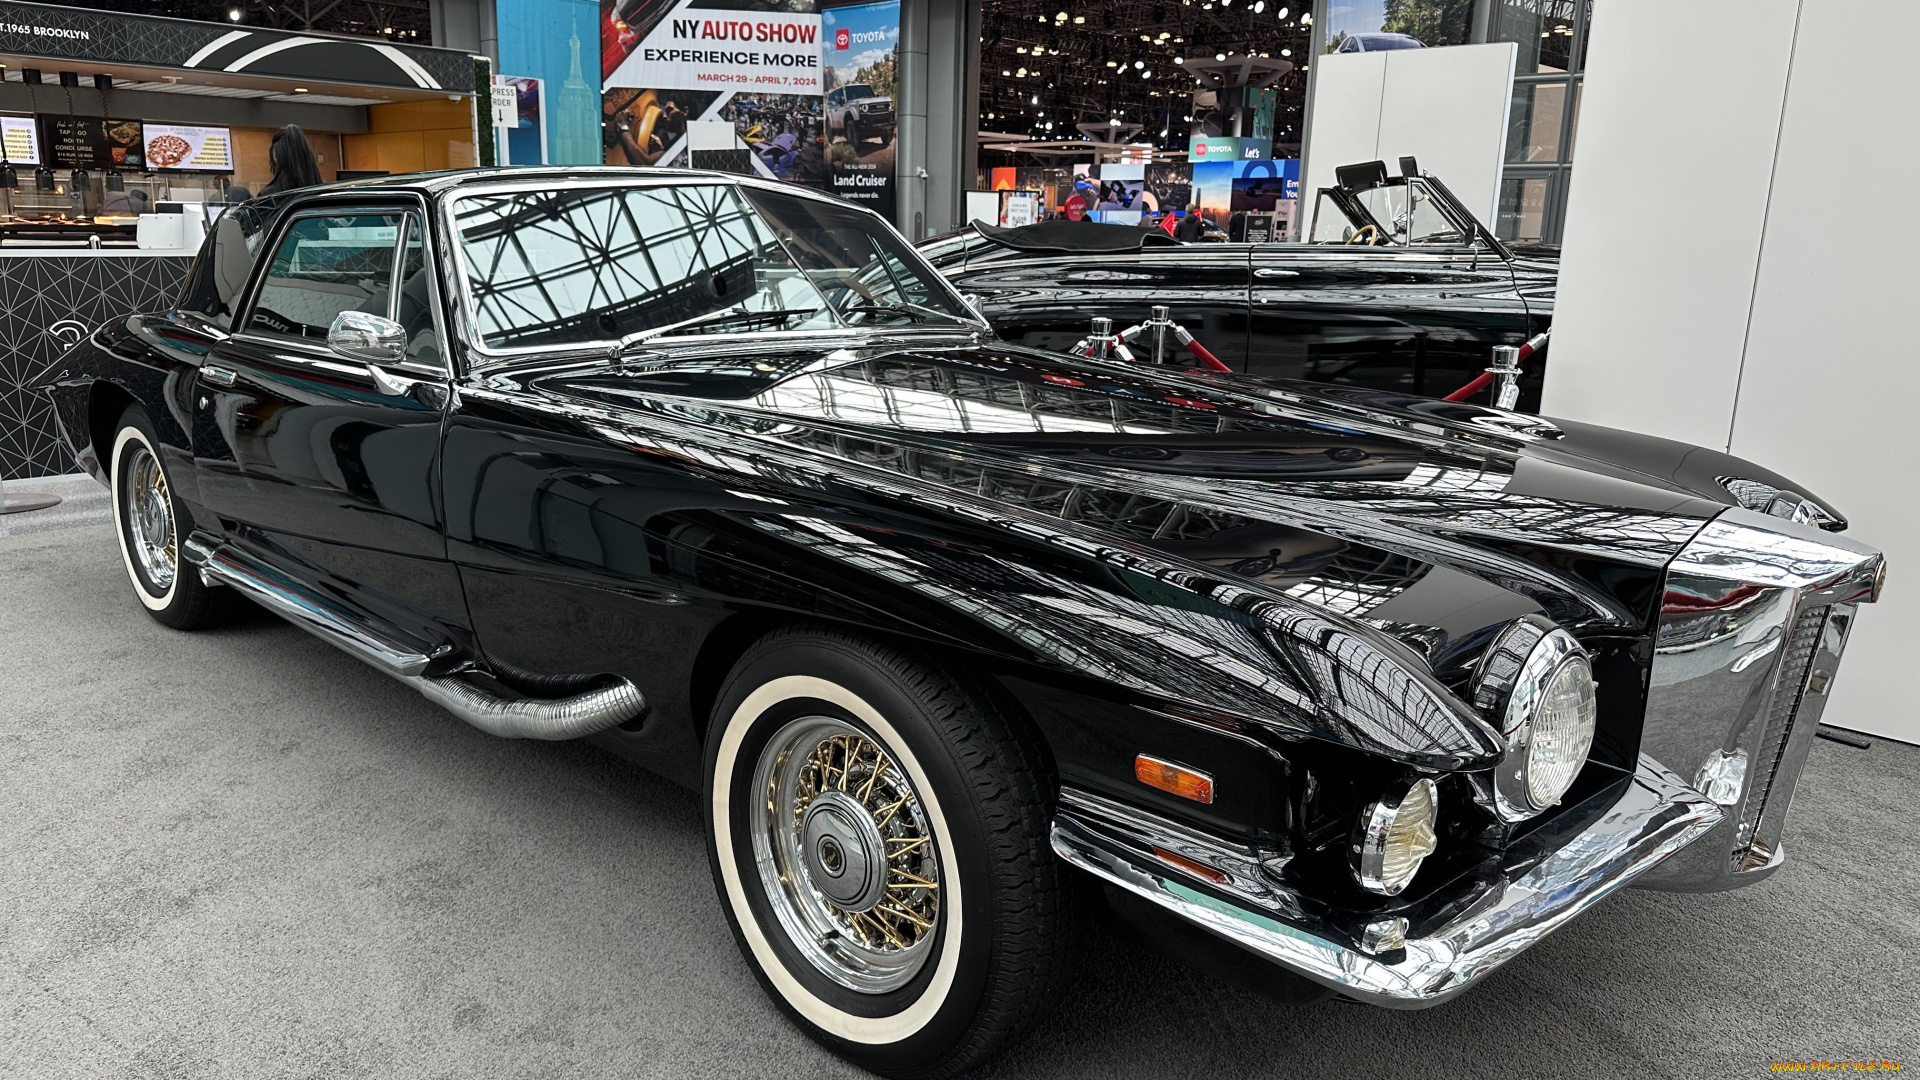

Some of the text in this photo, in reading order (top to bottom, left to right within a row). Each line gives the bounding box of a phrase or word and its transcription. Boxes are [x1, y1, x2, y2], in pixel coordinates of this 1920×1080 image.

[34, 26, 89, 40] BROOKLYN
[673, 20, 816, 44] NY AUTO SHOW
[852, 30, 885, 43] TOYOTA
[644, 49, 817, 67] EXPERIENCE MORE
[697, 74, 733, 82] MARCH
[754, 76, 780, 84] APRIL
[793, 77, 817, 86] 2024
[1245, 147, 1260, 159] Let's
[834, 174, 887, 186] Land Cruiser
